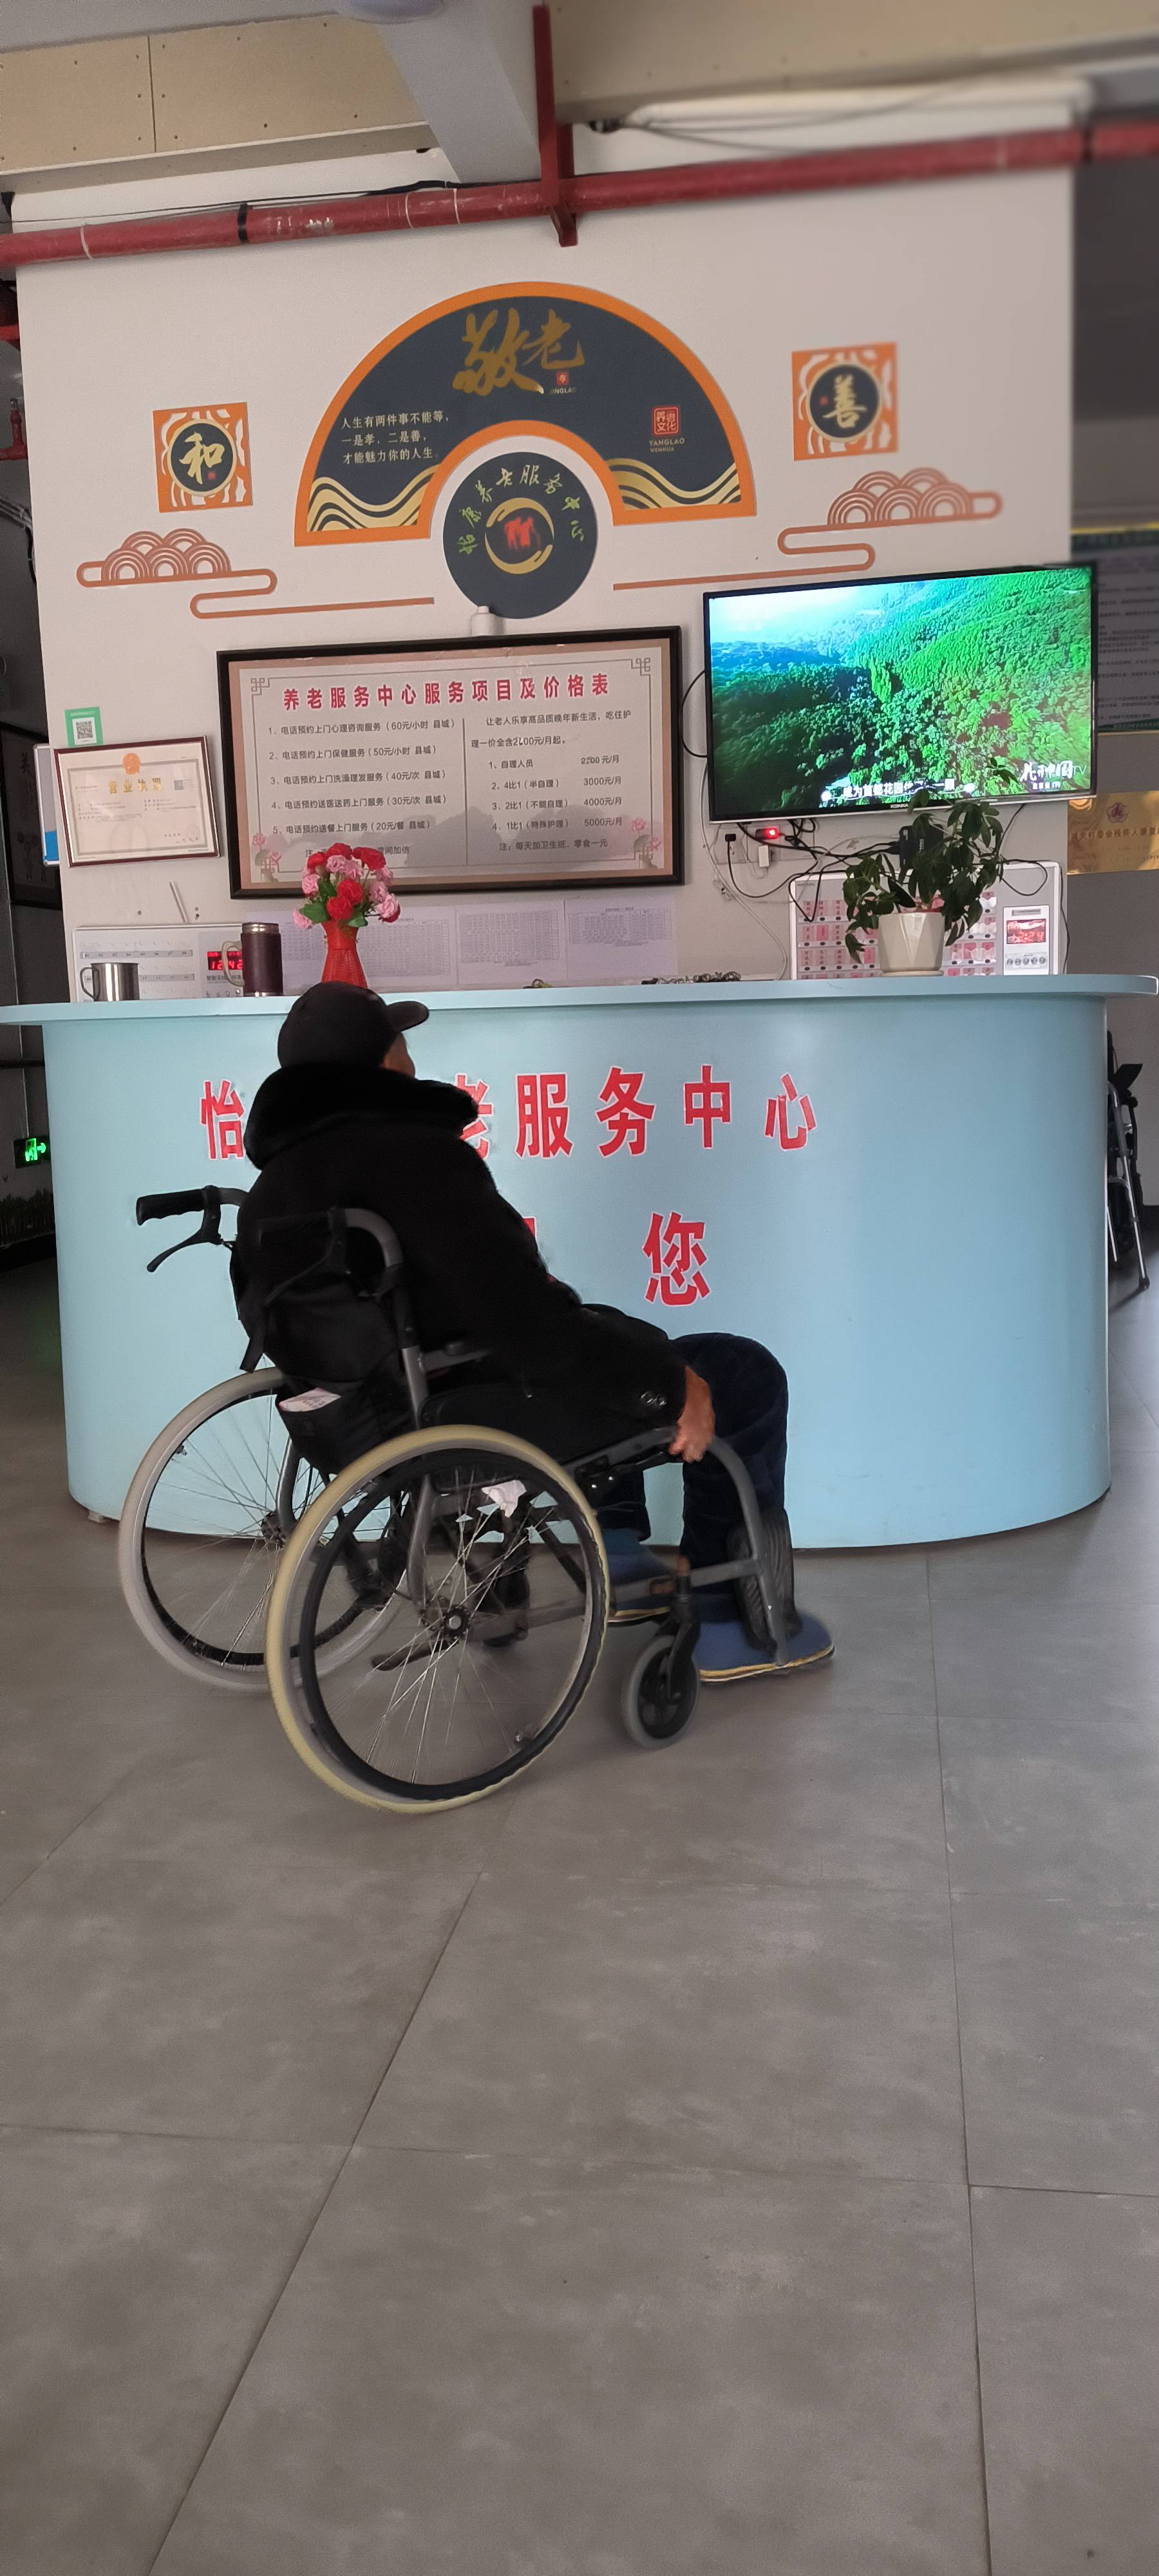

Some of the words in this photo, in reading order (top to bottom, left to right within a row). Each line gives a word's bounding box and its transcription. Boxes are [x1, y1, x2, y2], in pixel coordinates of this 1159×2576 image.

[452, 308, 585, 397] 敬老
[822, 374, 867, 429] 善
[178, 432, 225, 485] 和
[649, 438, 685, 446] YANGLAO
[283, 673, 609, 711] 养老服务中心服务项目及价格表
[583, 775, 622, 786] 3000元/月
[583, 796, 623, 806] 4000元/月
[584, 817, 623, 827] 5000元/月
[199, 1065, 817, 1161] 怡老服务中心
[643, 1211, 710, 1306] 您
